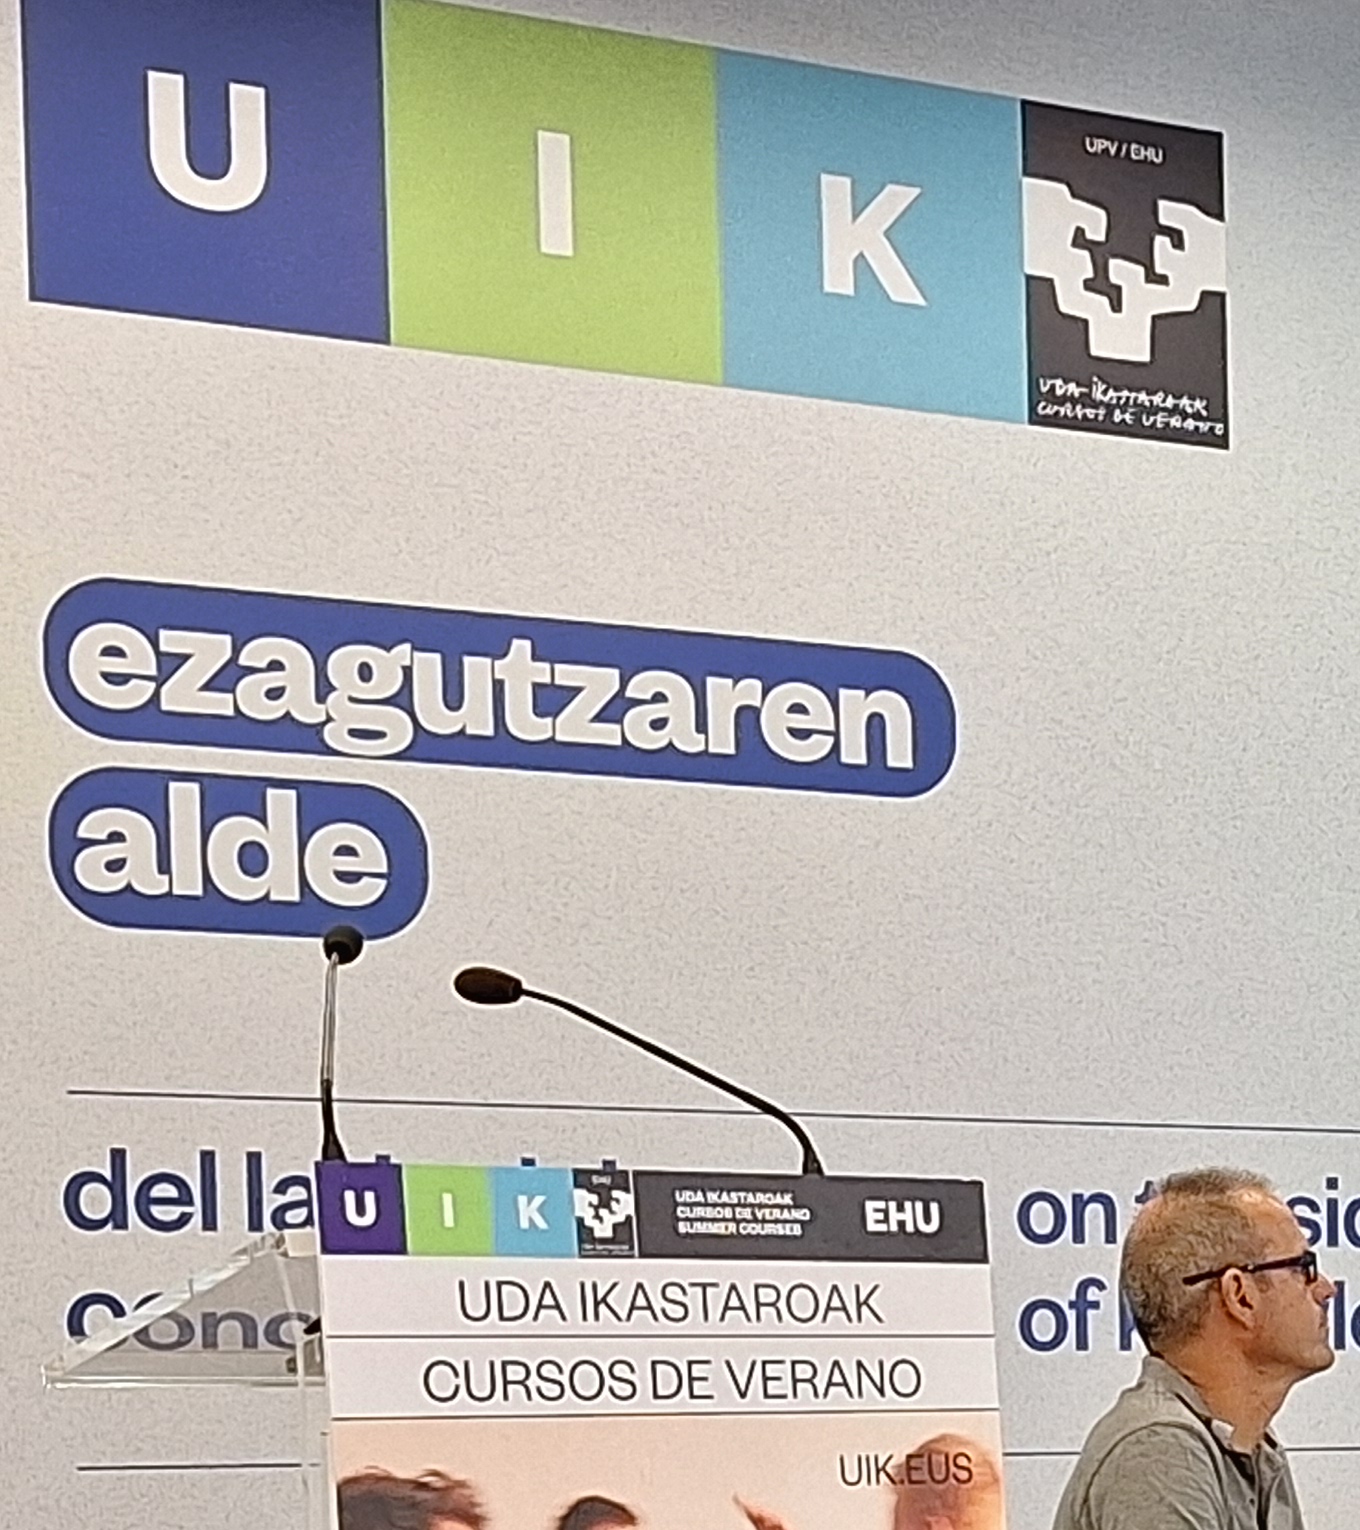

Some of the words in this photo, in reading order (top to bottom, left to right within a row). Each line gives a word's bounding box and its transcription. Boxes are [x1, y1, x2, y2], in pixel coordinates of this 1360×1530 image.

[1085, 137, 1118, 158] UPV
[1130, 143, 1164, 164] EHU
[68, 621, 914, 768] ezagutzaren
[74, 782, 388, 907] alde
[63, 1147, 218, 1232] del
[1016, 1190, 1118, 1246] on
[675, 1190, 704, 1203] UDA
[706, 1190, 794, 1205] IKASTAROAK
[754, 1208, 810, 1220] VERANO
[865, 1200, 941, 1233] EHU
[458, 1279, 567, 1323] UDA
[579, 1280, 885, 1324] IKASTAROAK
[1019, 1277, 1106, 1353] of
[422, 1359, 636, 1402] CURSOS
[651, 1360, 714, 1400] DE
[724, 1359, 921, 1400] VERANO
[840, 1452, 973, 1486] UIK.EUS
